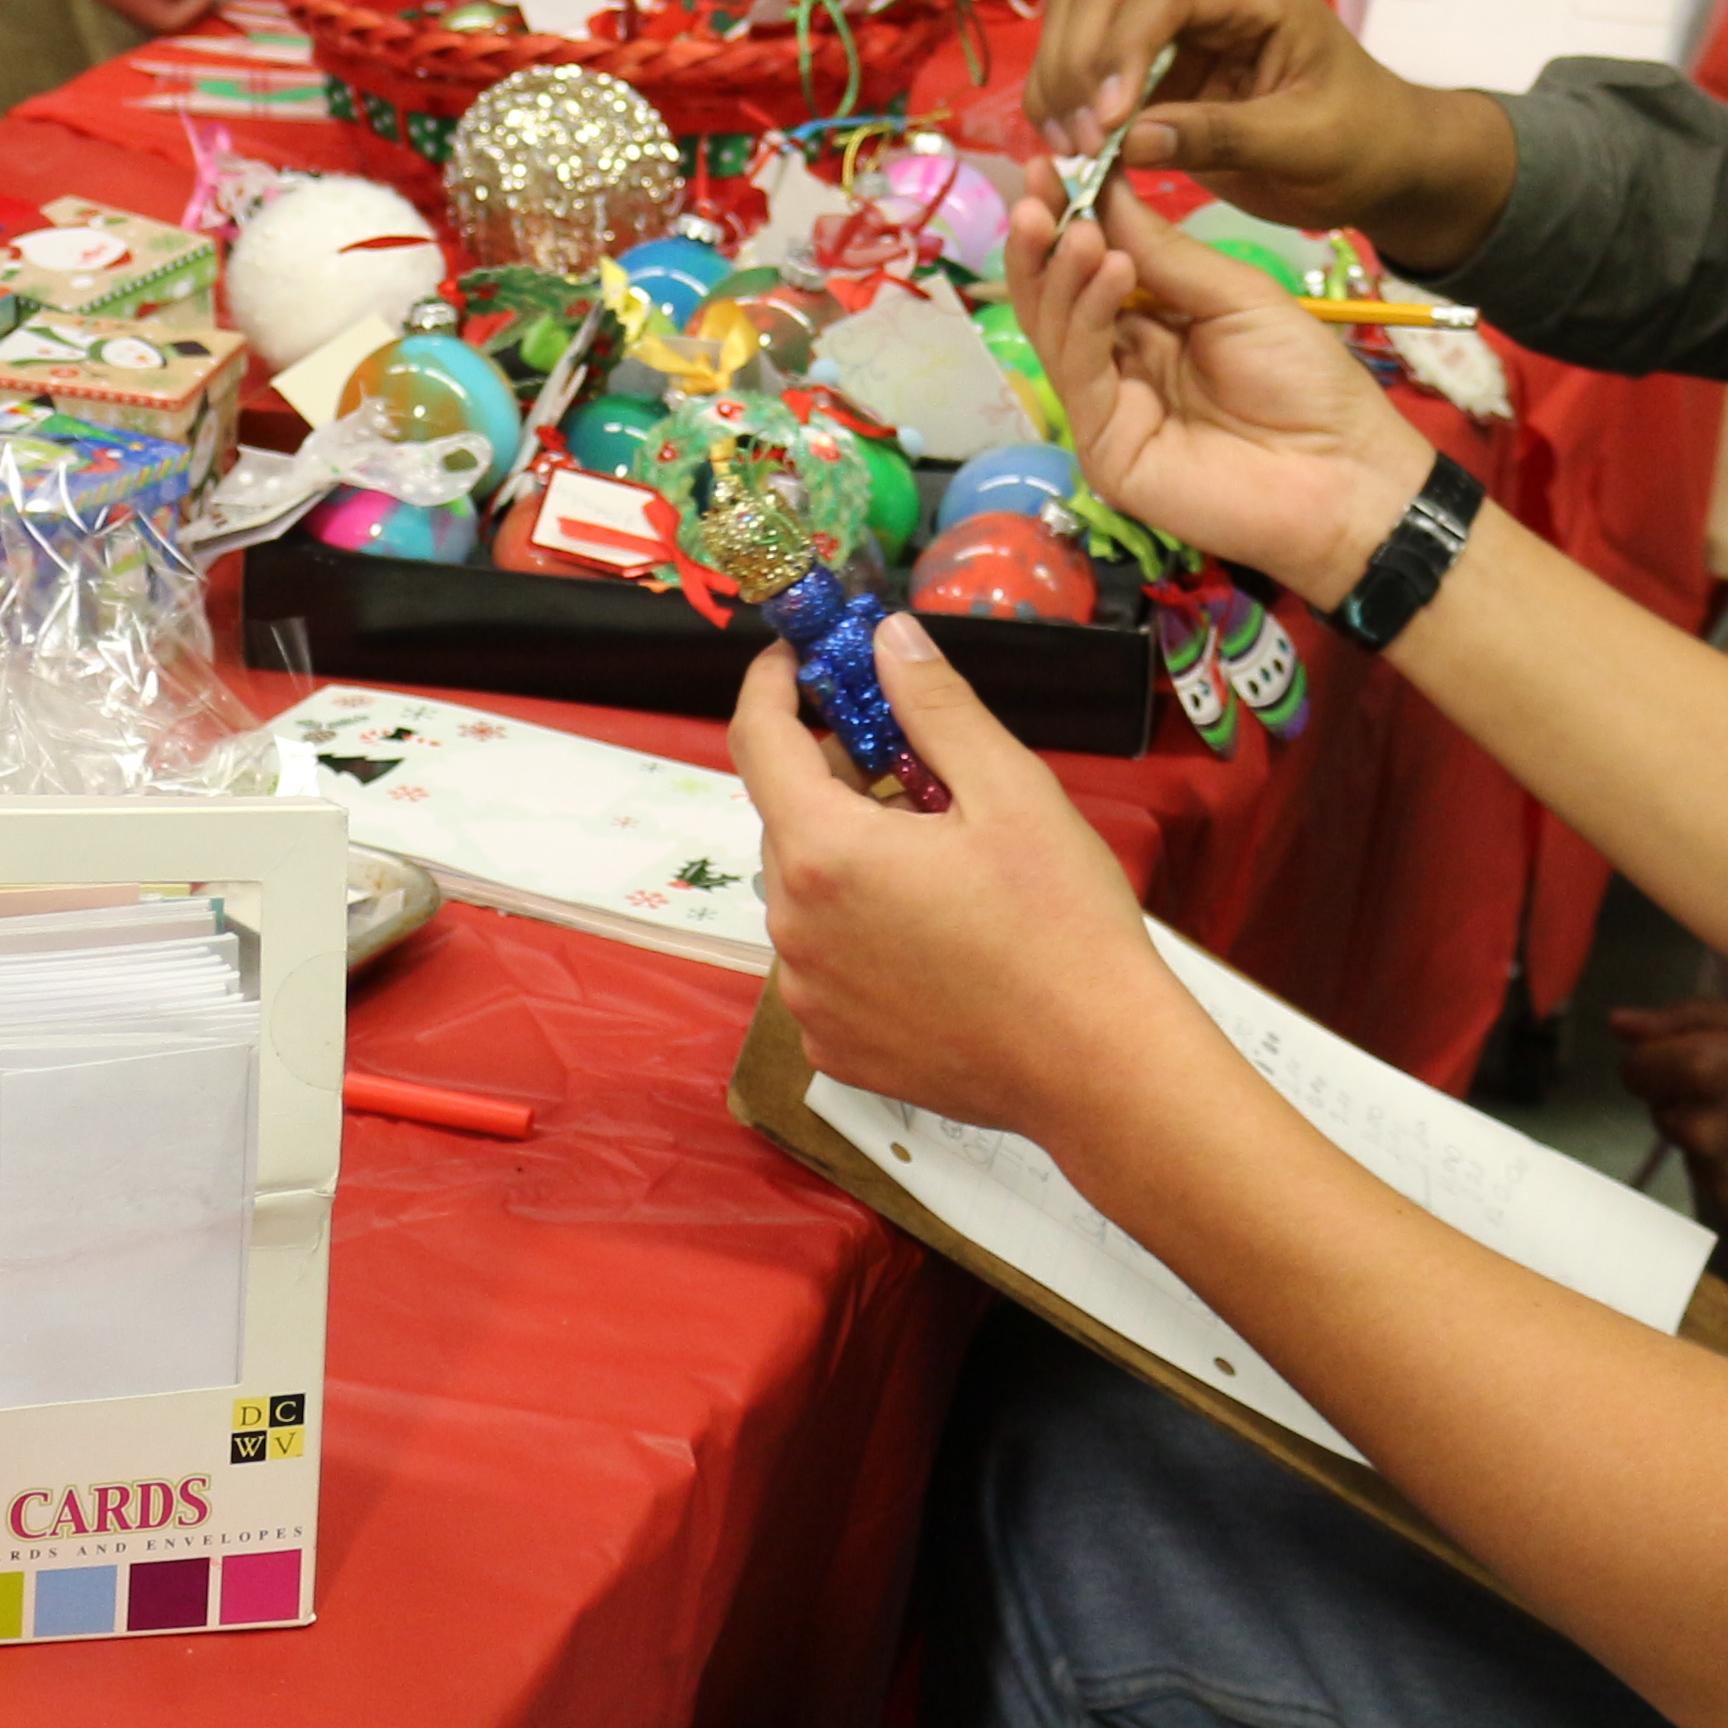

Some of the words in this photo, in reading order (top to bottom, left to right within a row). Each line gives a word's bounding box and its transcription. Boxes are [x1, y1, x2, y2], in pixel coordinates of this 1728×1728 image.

[9, 1473, 210, 1541] CARDS
[77, 1541, 128, 1556] AND
[146, 1525, 304, 1552] ENVELOPES
